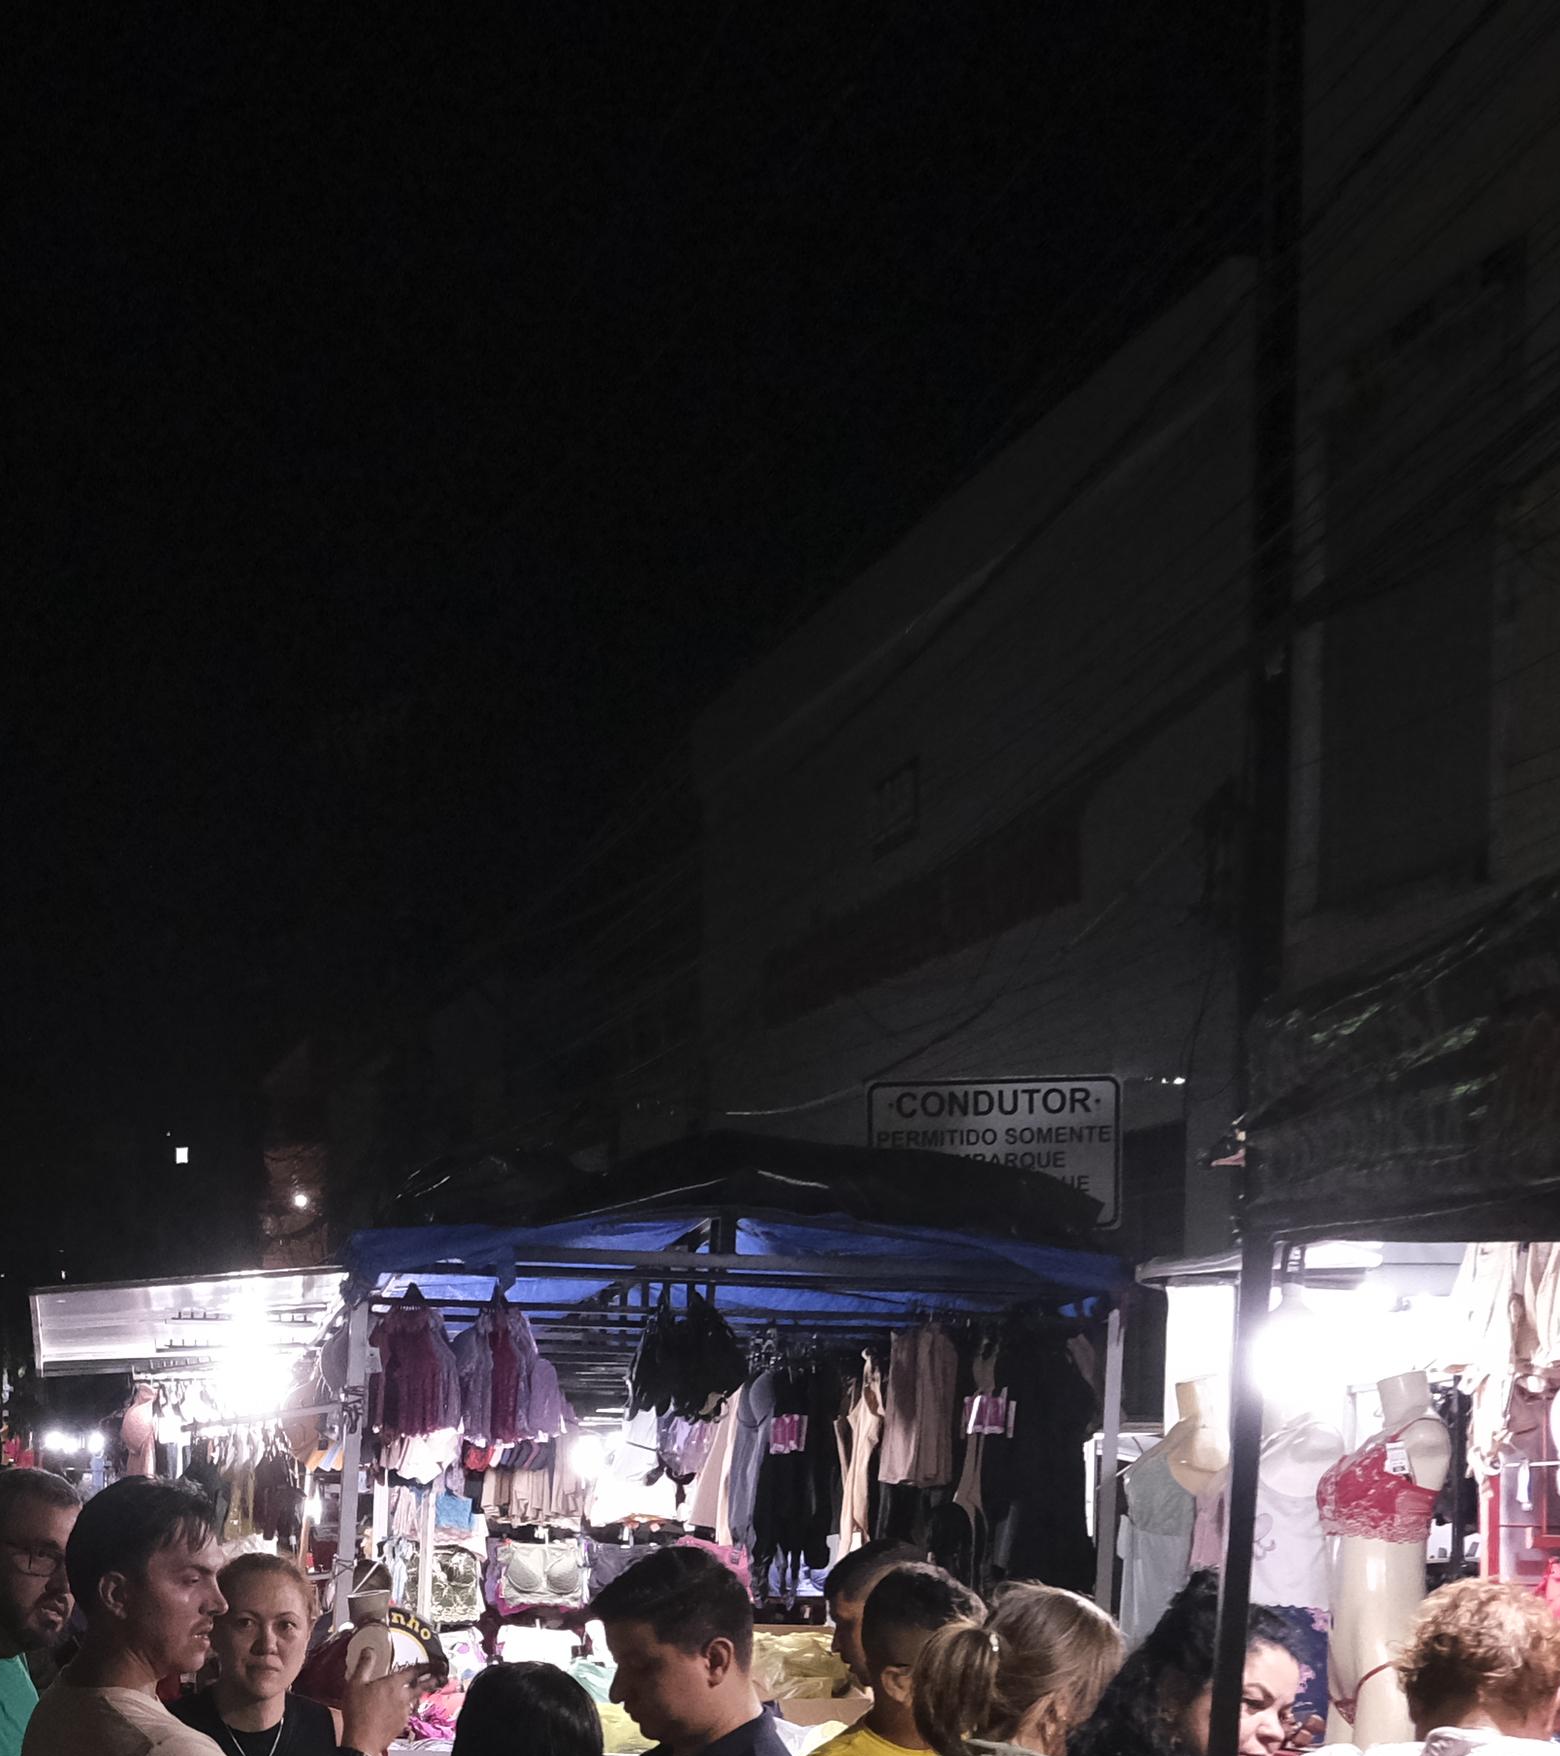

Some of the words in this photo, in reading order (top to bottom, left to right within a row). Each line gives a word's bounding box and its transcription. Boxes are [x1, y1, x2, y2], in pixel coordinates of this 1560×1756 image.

[894, 1087, 1093, 1119] CONDUTOR
[876, 1128, 998, 1149] PERMITIDO
[1004, 1125, 1112, 1145] SOMENTE
